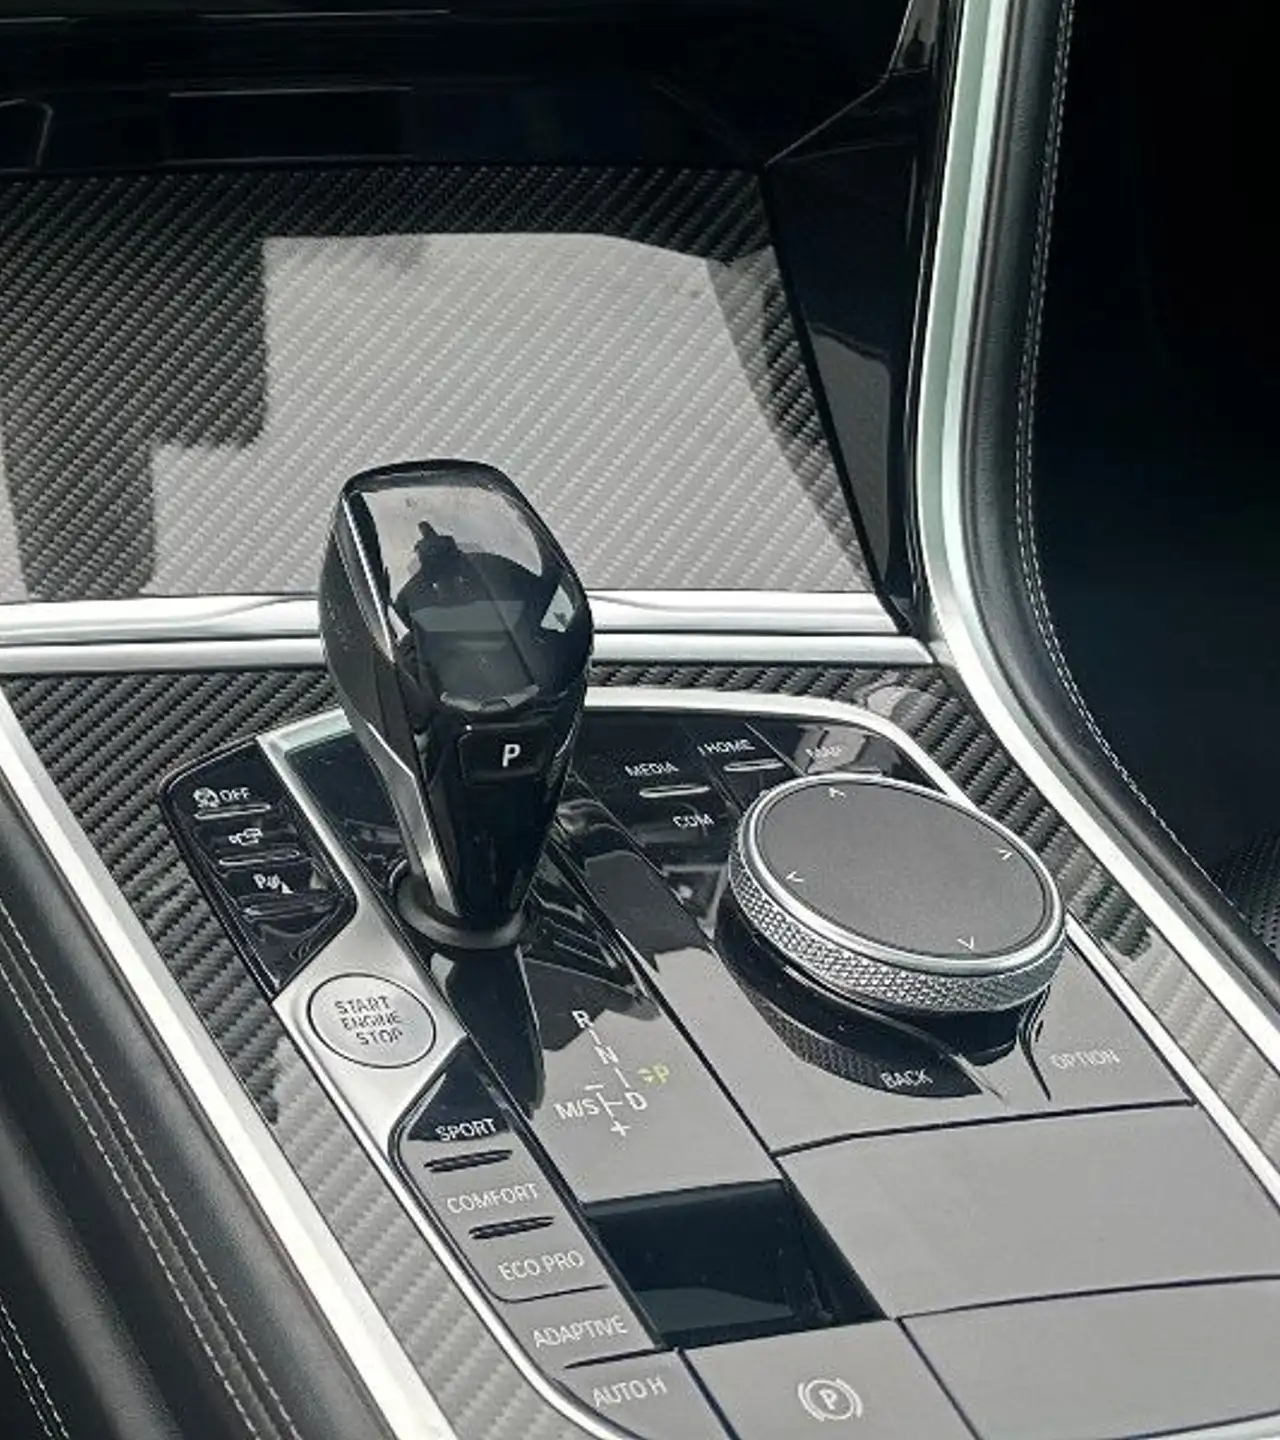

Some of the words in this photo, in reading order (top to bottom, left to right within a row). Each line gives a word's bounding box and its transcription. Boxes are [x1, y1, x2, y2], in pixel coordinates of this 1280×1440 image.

[502, 743, 521, 768] P
[624, 761, 680, 777] MEDIA
[333, 995, 392, 1017] START
[339, 1012, 403, 1032] ENGINE
[571, 1009, 595, 1030] R
[355, 1027, 405, 1047] STOP
[1048, 1049, 1121, 1071] OPTION
[879, 1068, 934, 1089] BACK
[553, 1098, 600, 1120] M/S
[624, 1090, 649, 1111] D
[434, 1117, 498, 1143] SPORT
[446, 1182, 541, 1215] COMFORT
[496, 1258, 541, 1282] ECO
[541, 1250, 586, 1275] PRO
[532, 1314, 630, 1348] ADAPTIVE
[590, 1381, 640, 1408] AUTO
[640, 1376, 668, 1396] H
